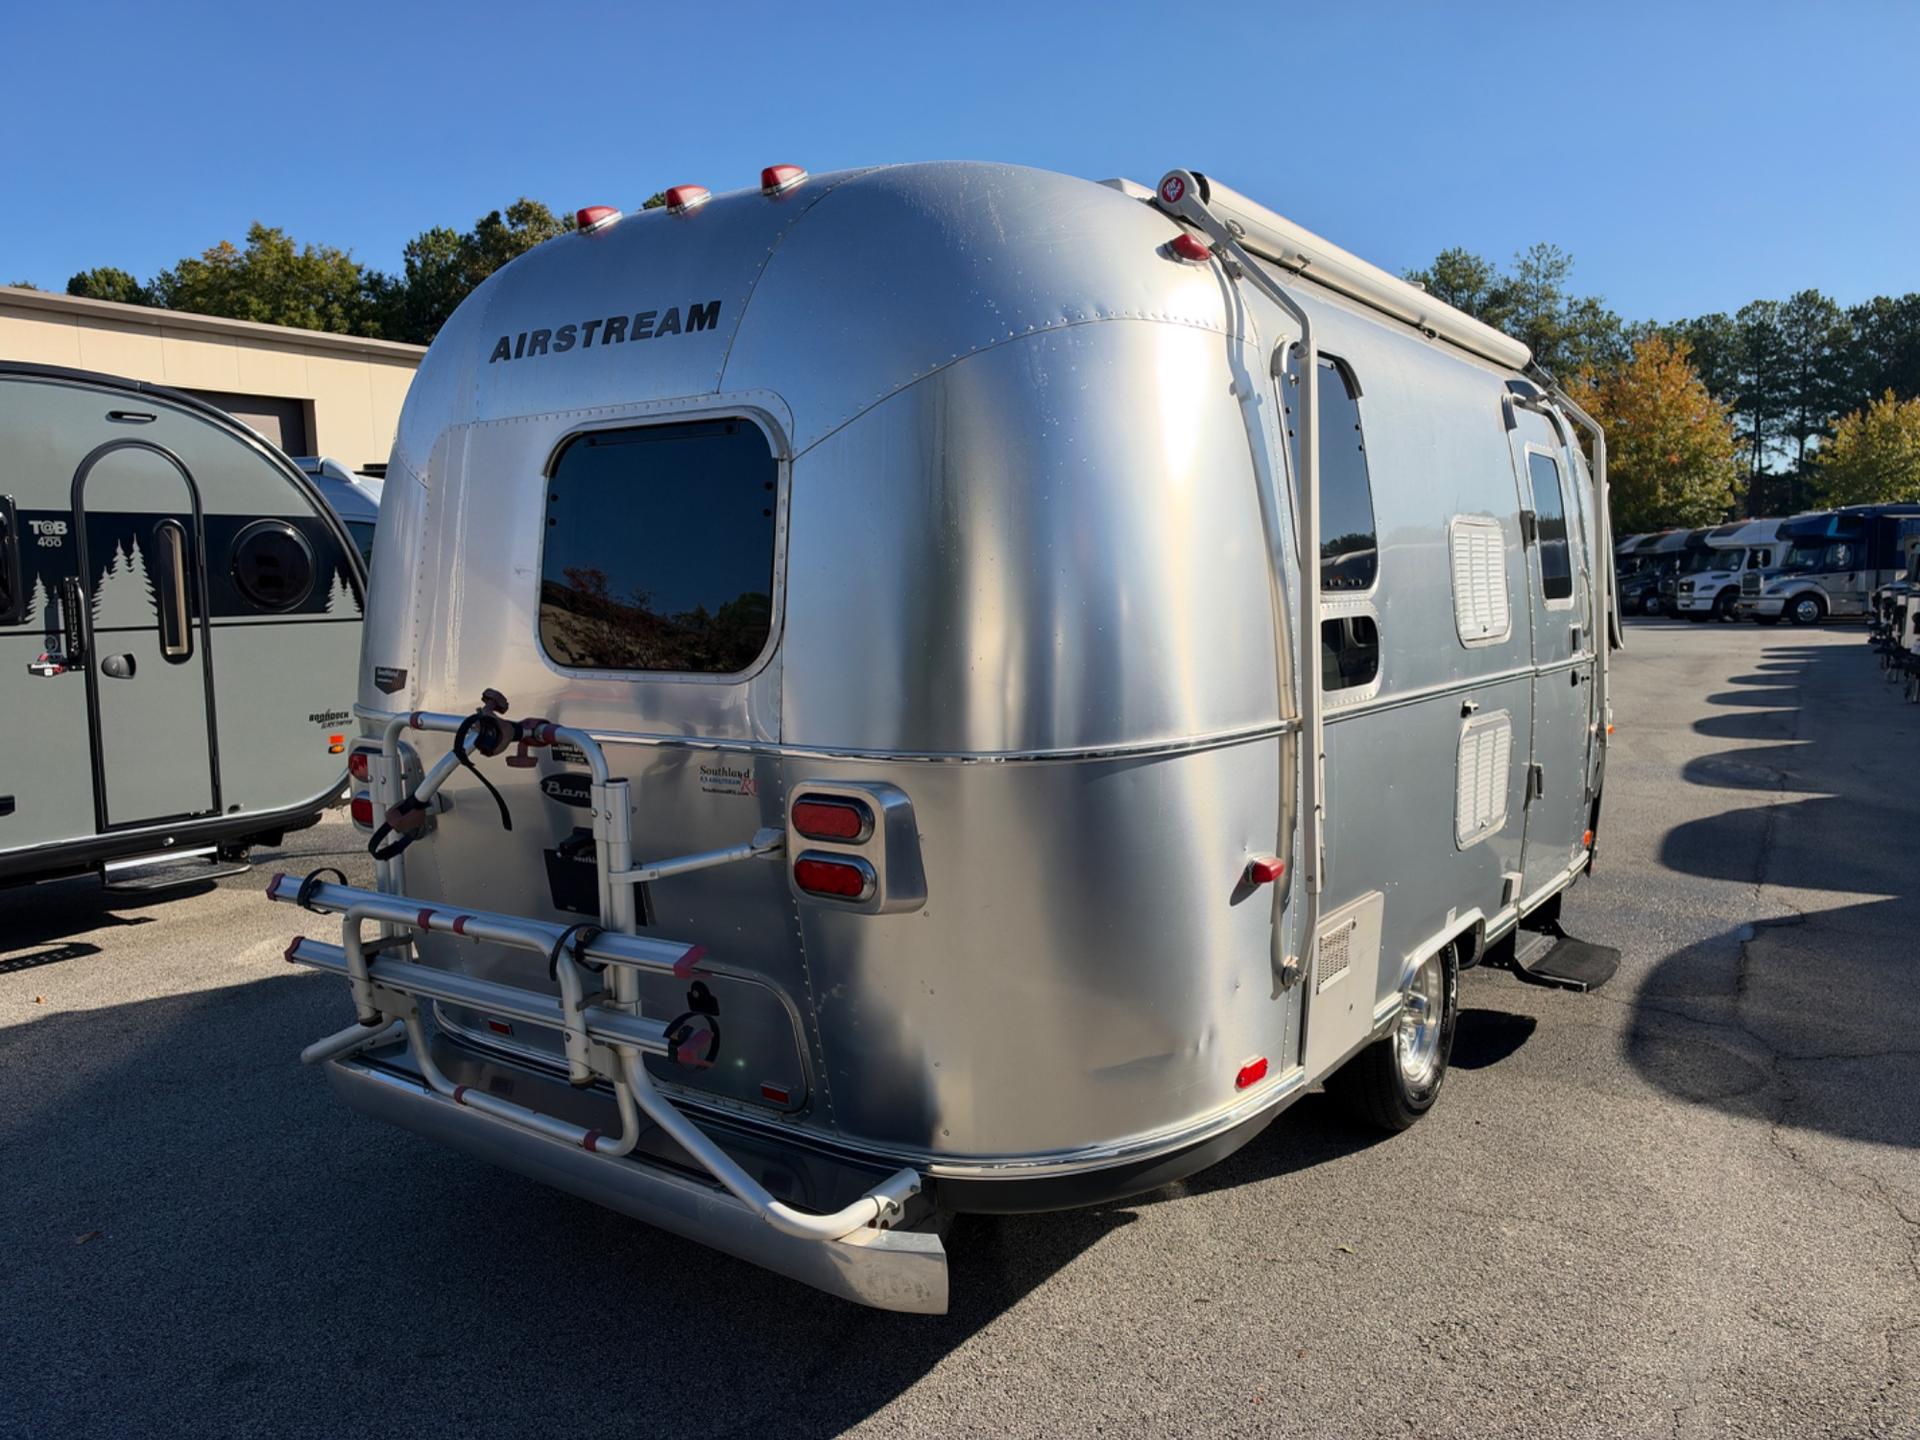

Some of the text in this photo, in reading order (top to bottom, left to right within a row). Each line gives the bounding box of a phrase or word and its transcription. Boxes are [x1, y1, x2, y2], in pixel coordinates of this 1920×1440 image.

[489, 300, 722, 363] AIRSTREAM
[28, 520, 68, 535] T@B
[37, 536, 62, 548] 400
[699, 765, 750, 778] Southland
[546, 781, 592, 799] Bam
